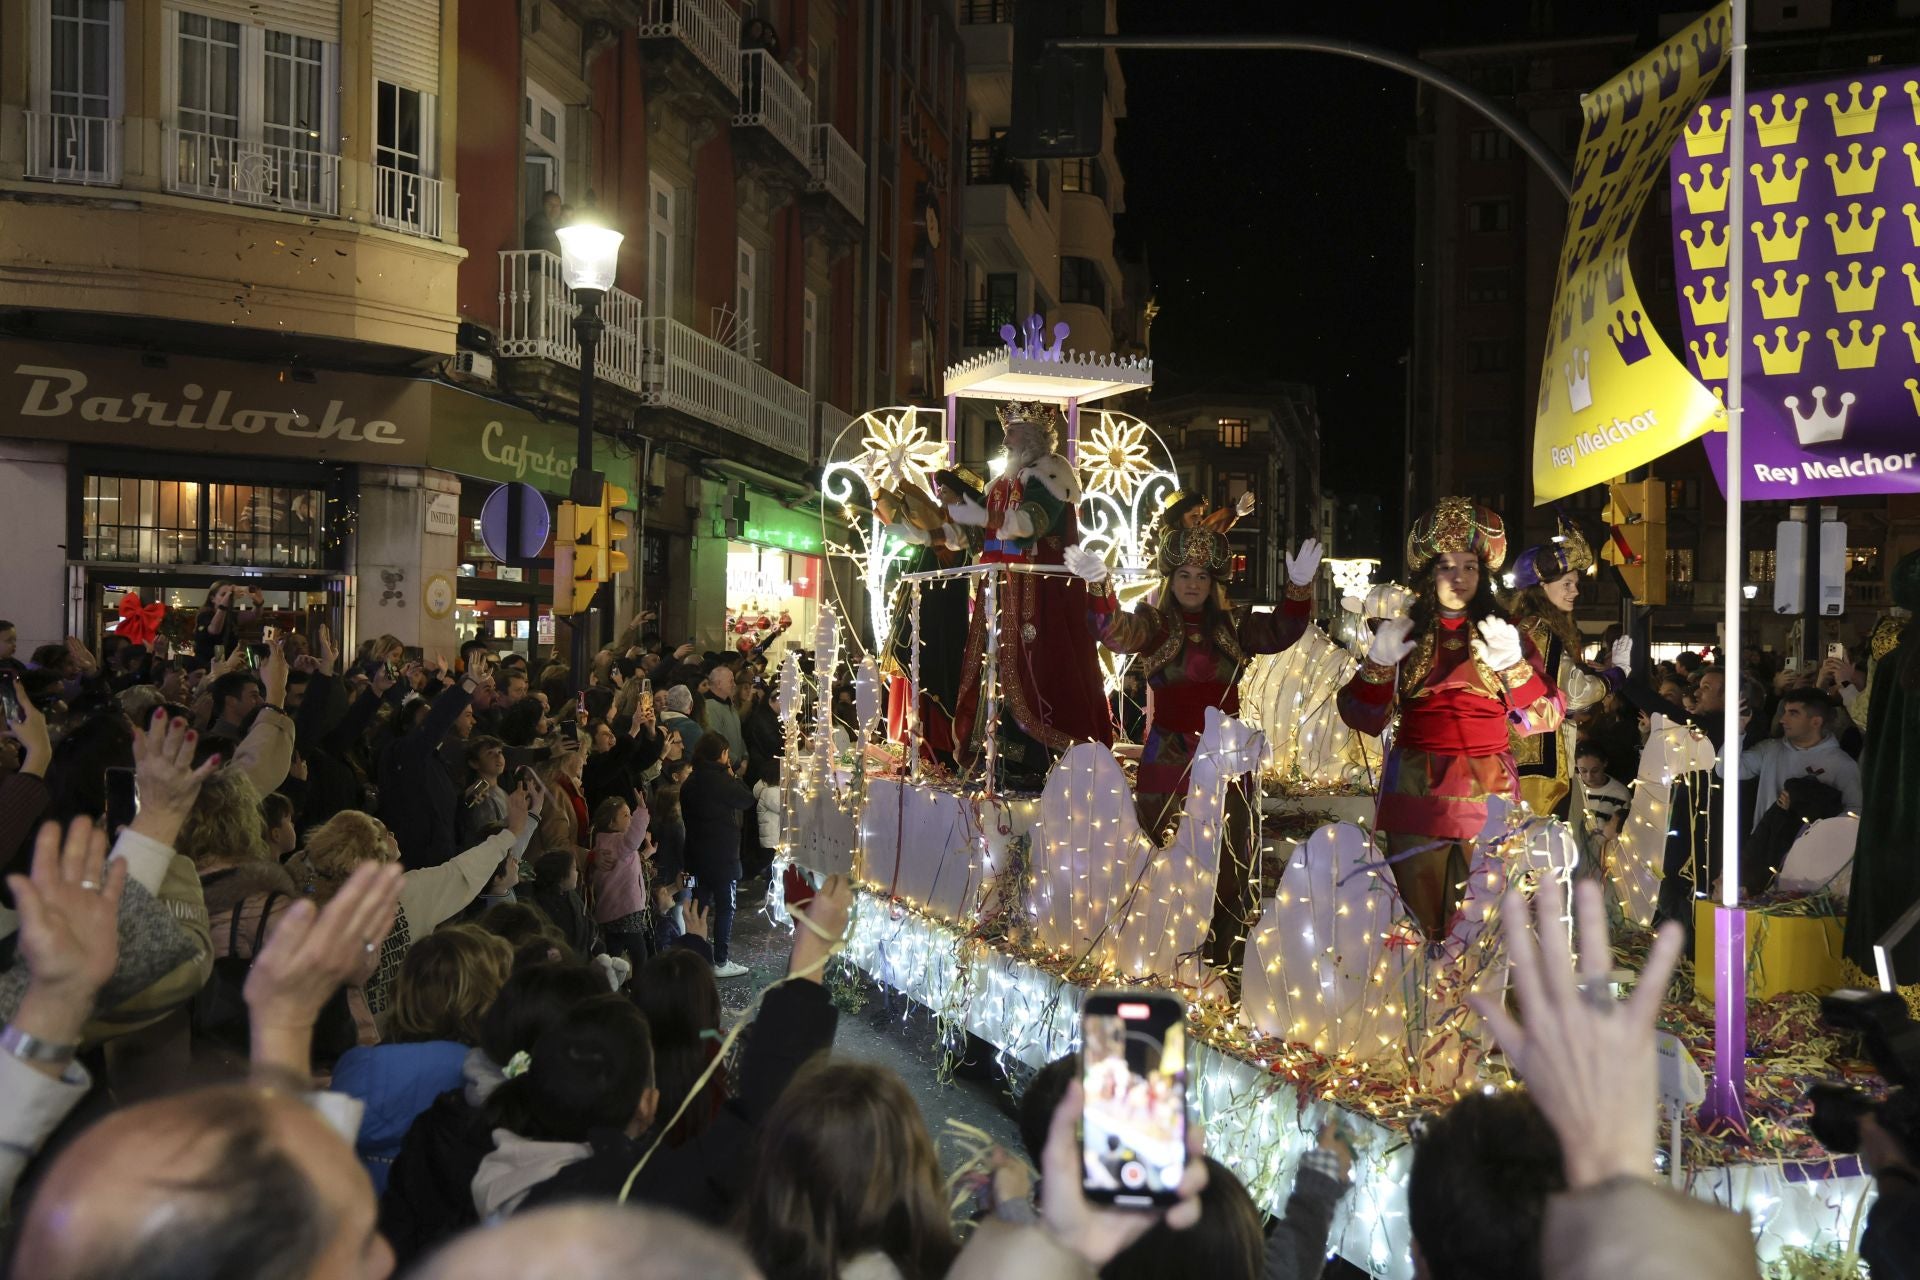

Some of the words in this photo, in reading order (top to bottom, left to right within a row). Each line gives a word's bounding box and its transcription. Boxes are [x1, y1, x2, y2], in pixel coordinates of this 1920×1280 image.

[13, 364, 407, 444] Bariloche
[481, 420, 579, 480] Cafeter
[1552, 437, 1577, 469] Rey
[1576, 407, 1659, 455] Melchor
[1753, 463, 1799, 486] Rey
[1801, 450, 1917, 480] Melchor
[430, 510, 456, 526] INSTITUTO
